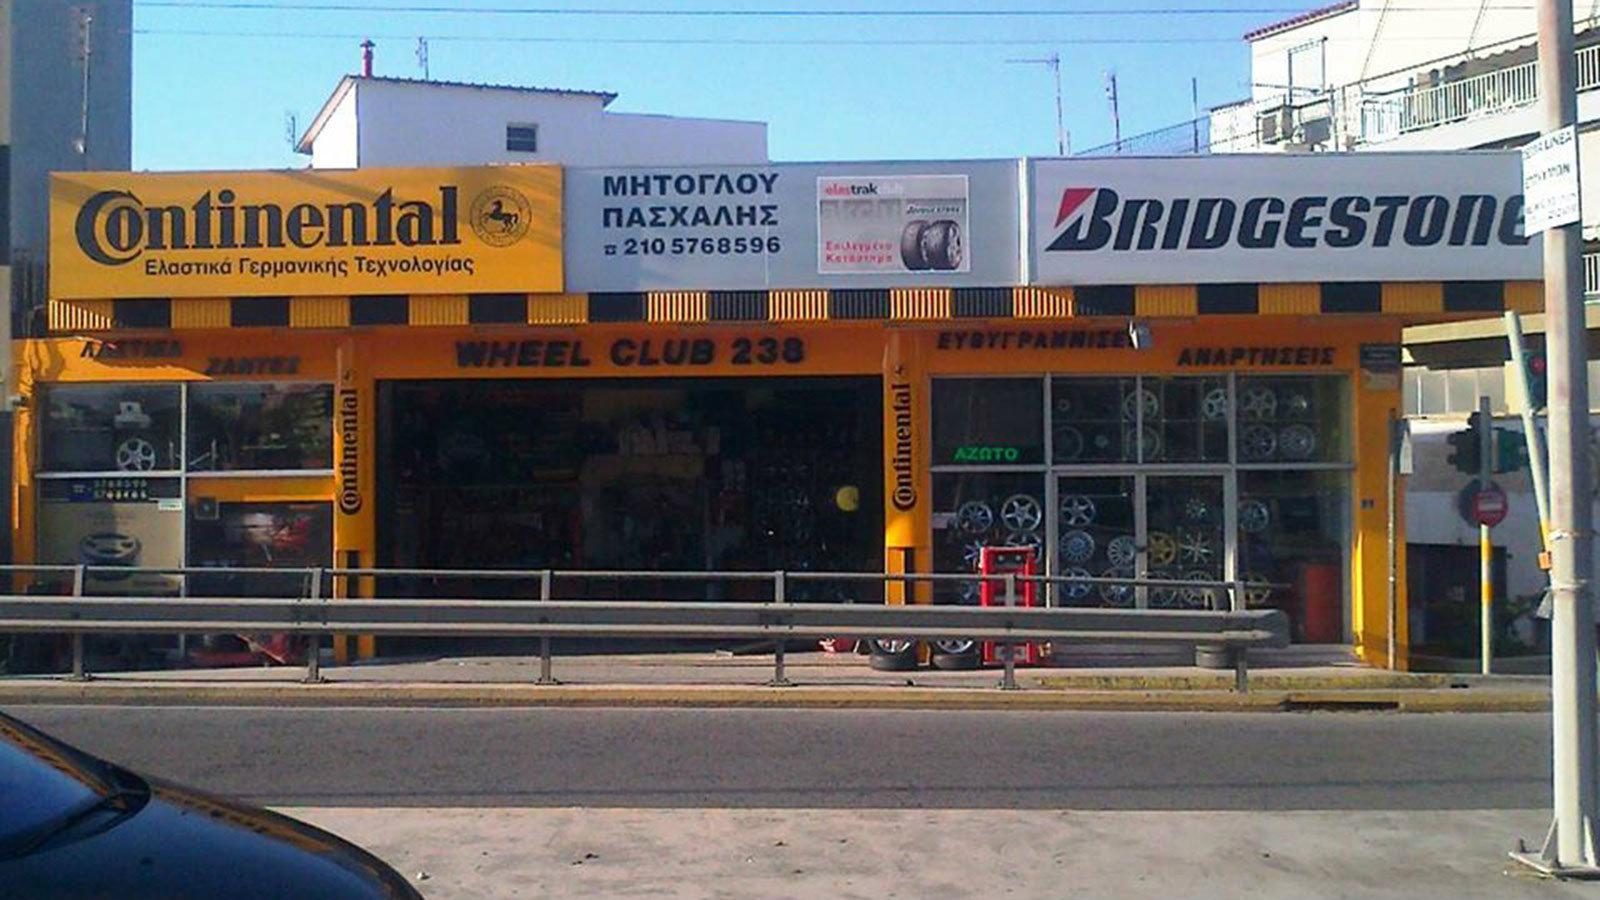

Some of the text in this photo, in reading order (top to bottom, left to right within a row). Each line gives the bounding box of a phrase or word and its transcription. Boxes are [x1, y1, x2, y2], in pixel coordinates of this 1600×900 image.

[603, 173, 779, 196] ΜΗΤΟΓΛΟΥ
[75, 185, 461, 266] Continental
[603, 206, 779, 229] ΠΑΣΧΑΛΗΣ
[625, 237, 781, 256] 210 5768596
[145, 256, 474, 278] Ελαστικά Γερμανικής Τεχνολογίας
[455, 337, 805, 368] WHEEL CLUB 238
[1177, 347, 1335, 366] ΑΝΑΡΤΗΣΕΙΣ
[340, 388, 362, 515] Continental
[893, 382, 917, 509] Continental
[953, 446, 1019, 462] ΑΖΩΤΟ
